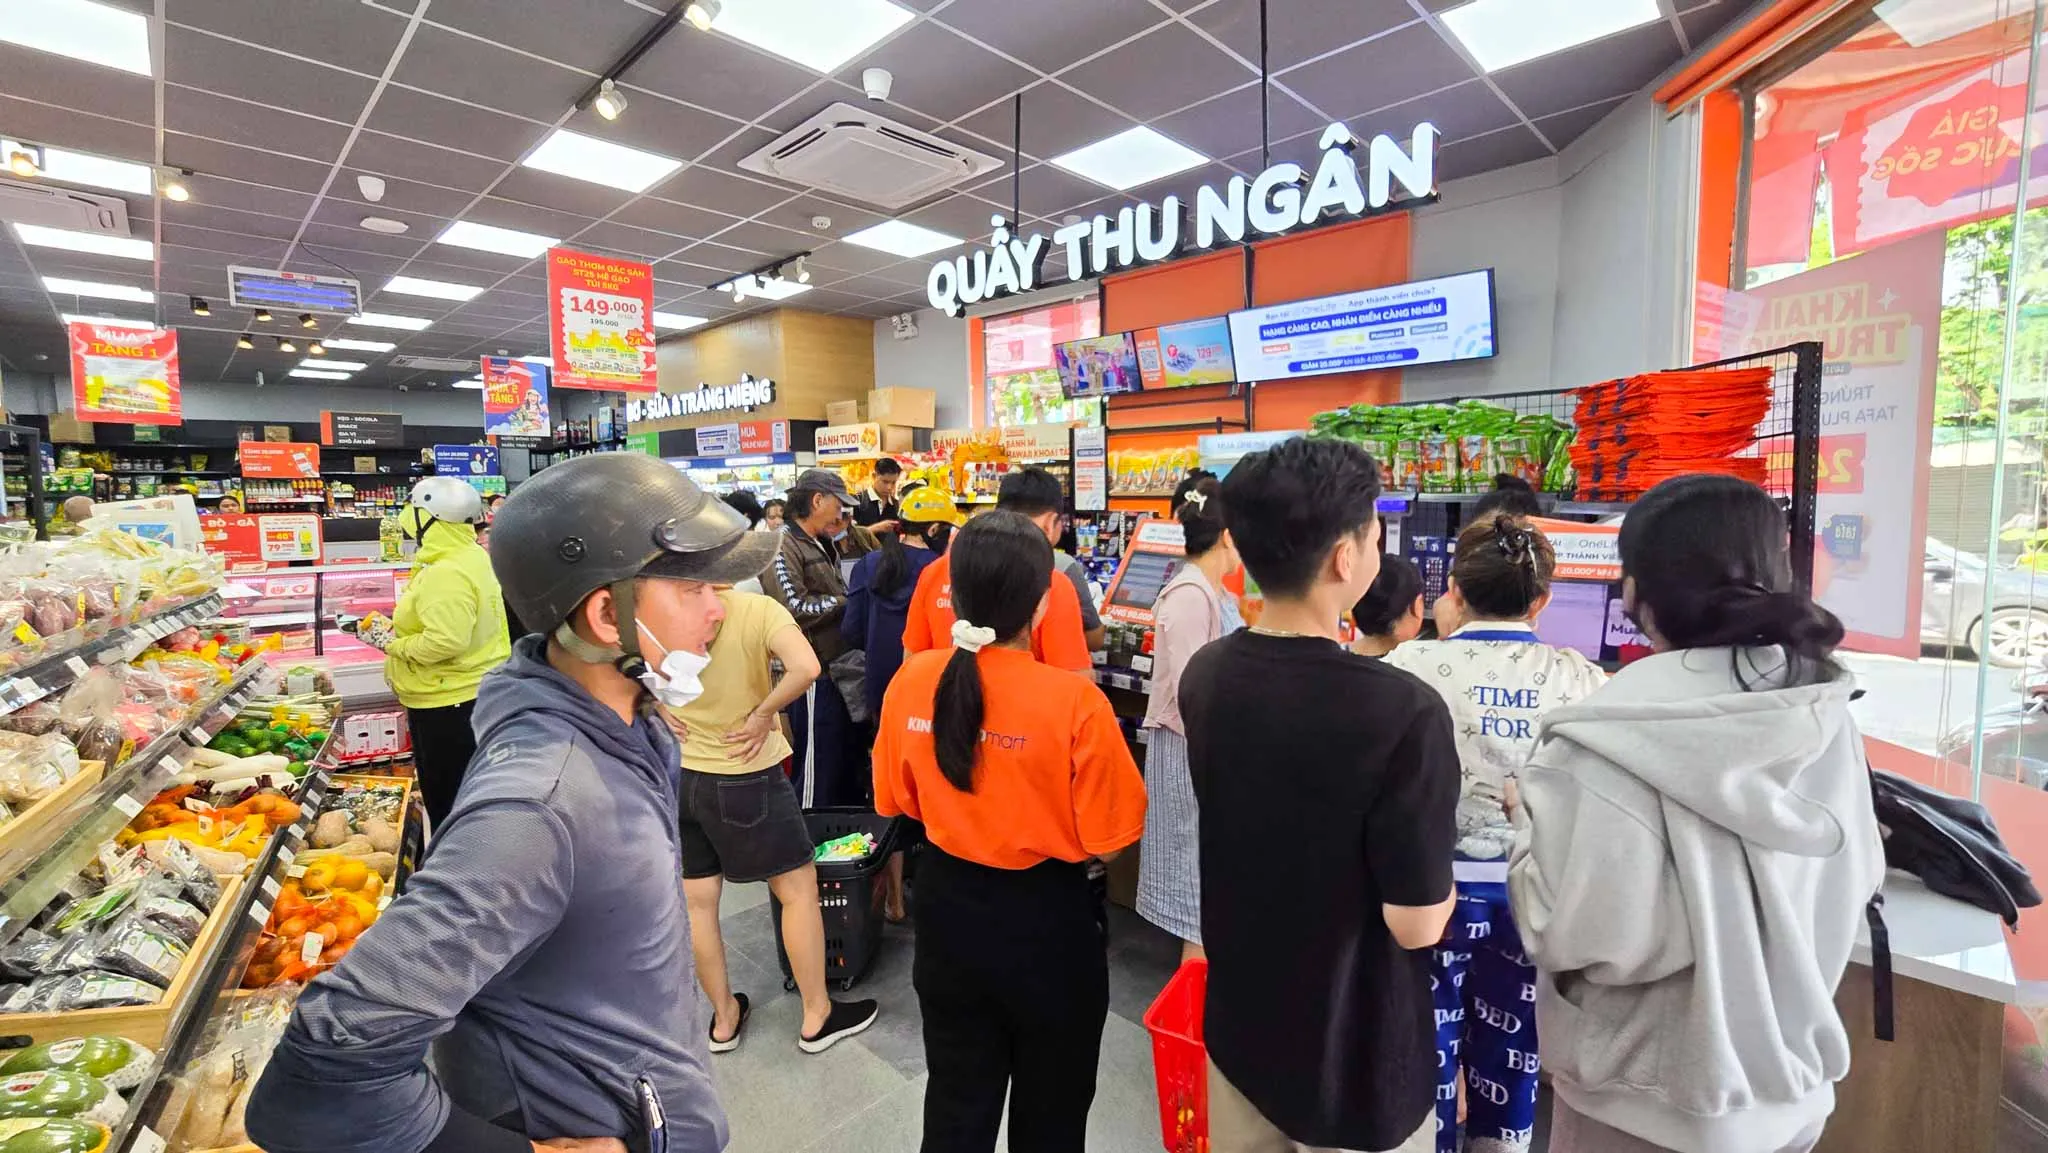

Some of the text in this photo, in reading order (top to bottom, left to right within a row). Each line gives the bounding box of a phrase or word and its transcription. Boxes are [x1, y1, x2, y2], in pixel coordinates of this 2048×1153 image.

[927, 121, 1438, 318] QUẦY THU NGÂN
[1383, 307, 1410, 320] CÀNG
[95, 329, 138, 343] MUA
[646, 391, 671, 420] SỮA
[672, 394, 681, 417] &
[680, 382, 724, 414] TRÁNG
[725, 372, 772, 413] MIỆNG
[741, 426, 756, 438] MUA
[817, 432, 859, 447] BÁNH TƯƠI
[934, 436, 959, 450] BÁNH
[1566, 551, 1599, 560] THÀNH
[1473, 685, 1540, 709] TIME
[1480, 716, 1533, 739] FOR
[1475, 996, 1522, 1034] BED
[1507, 1047, 1540, 1074] BE
[1469, 1066, 1509, 1105] BED
